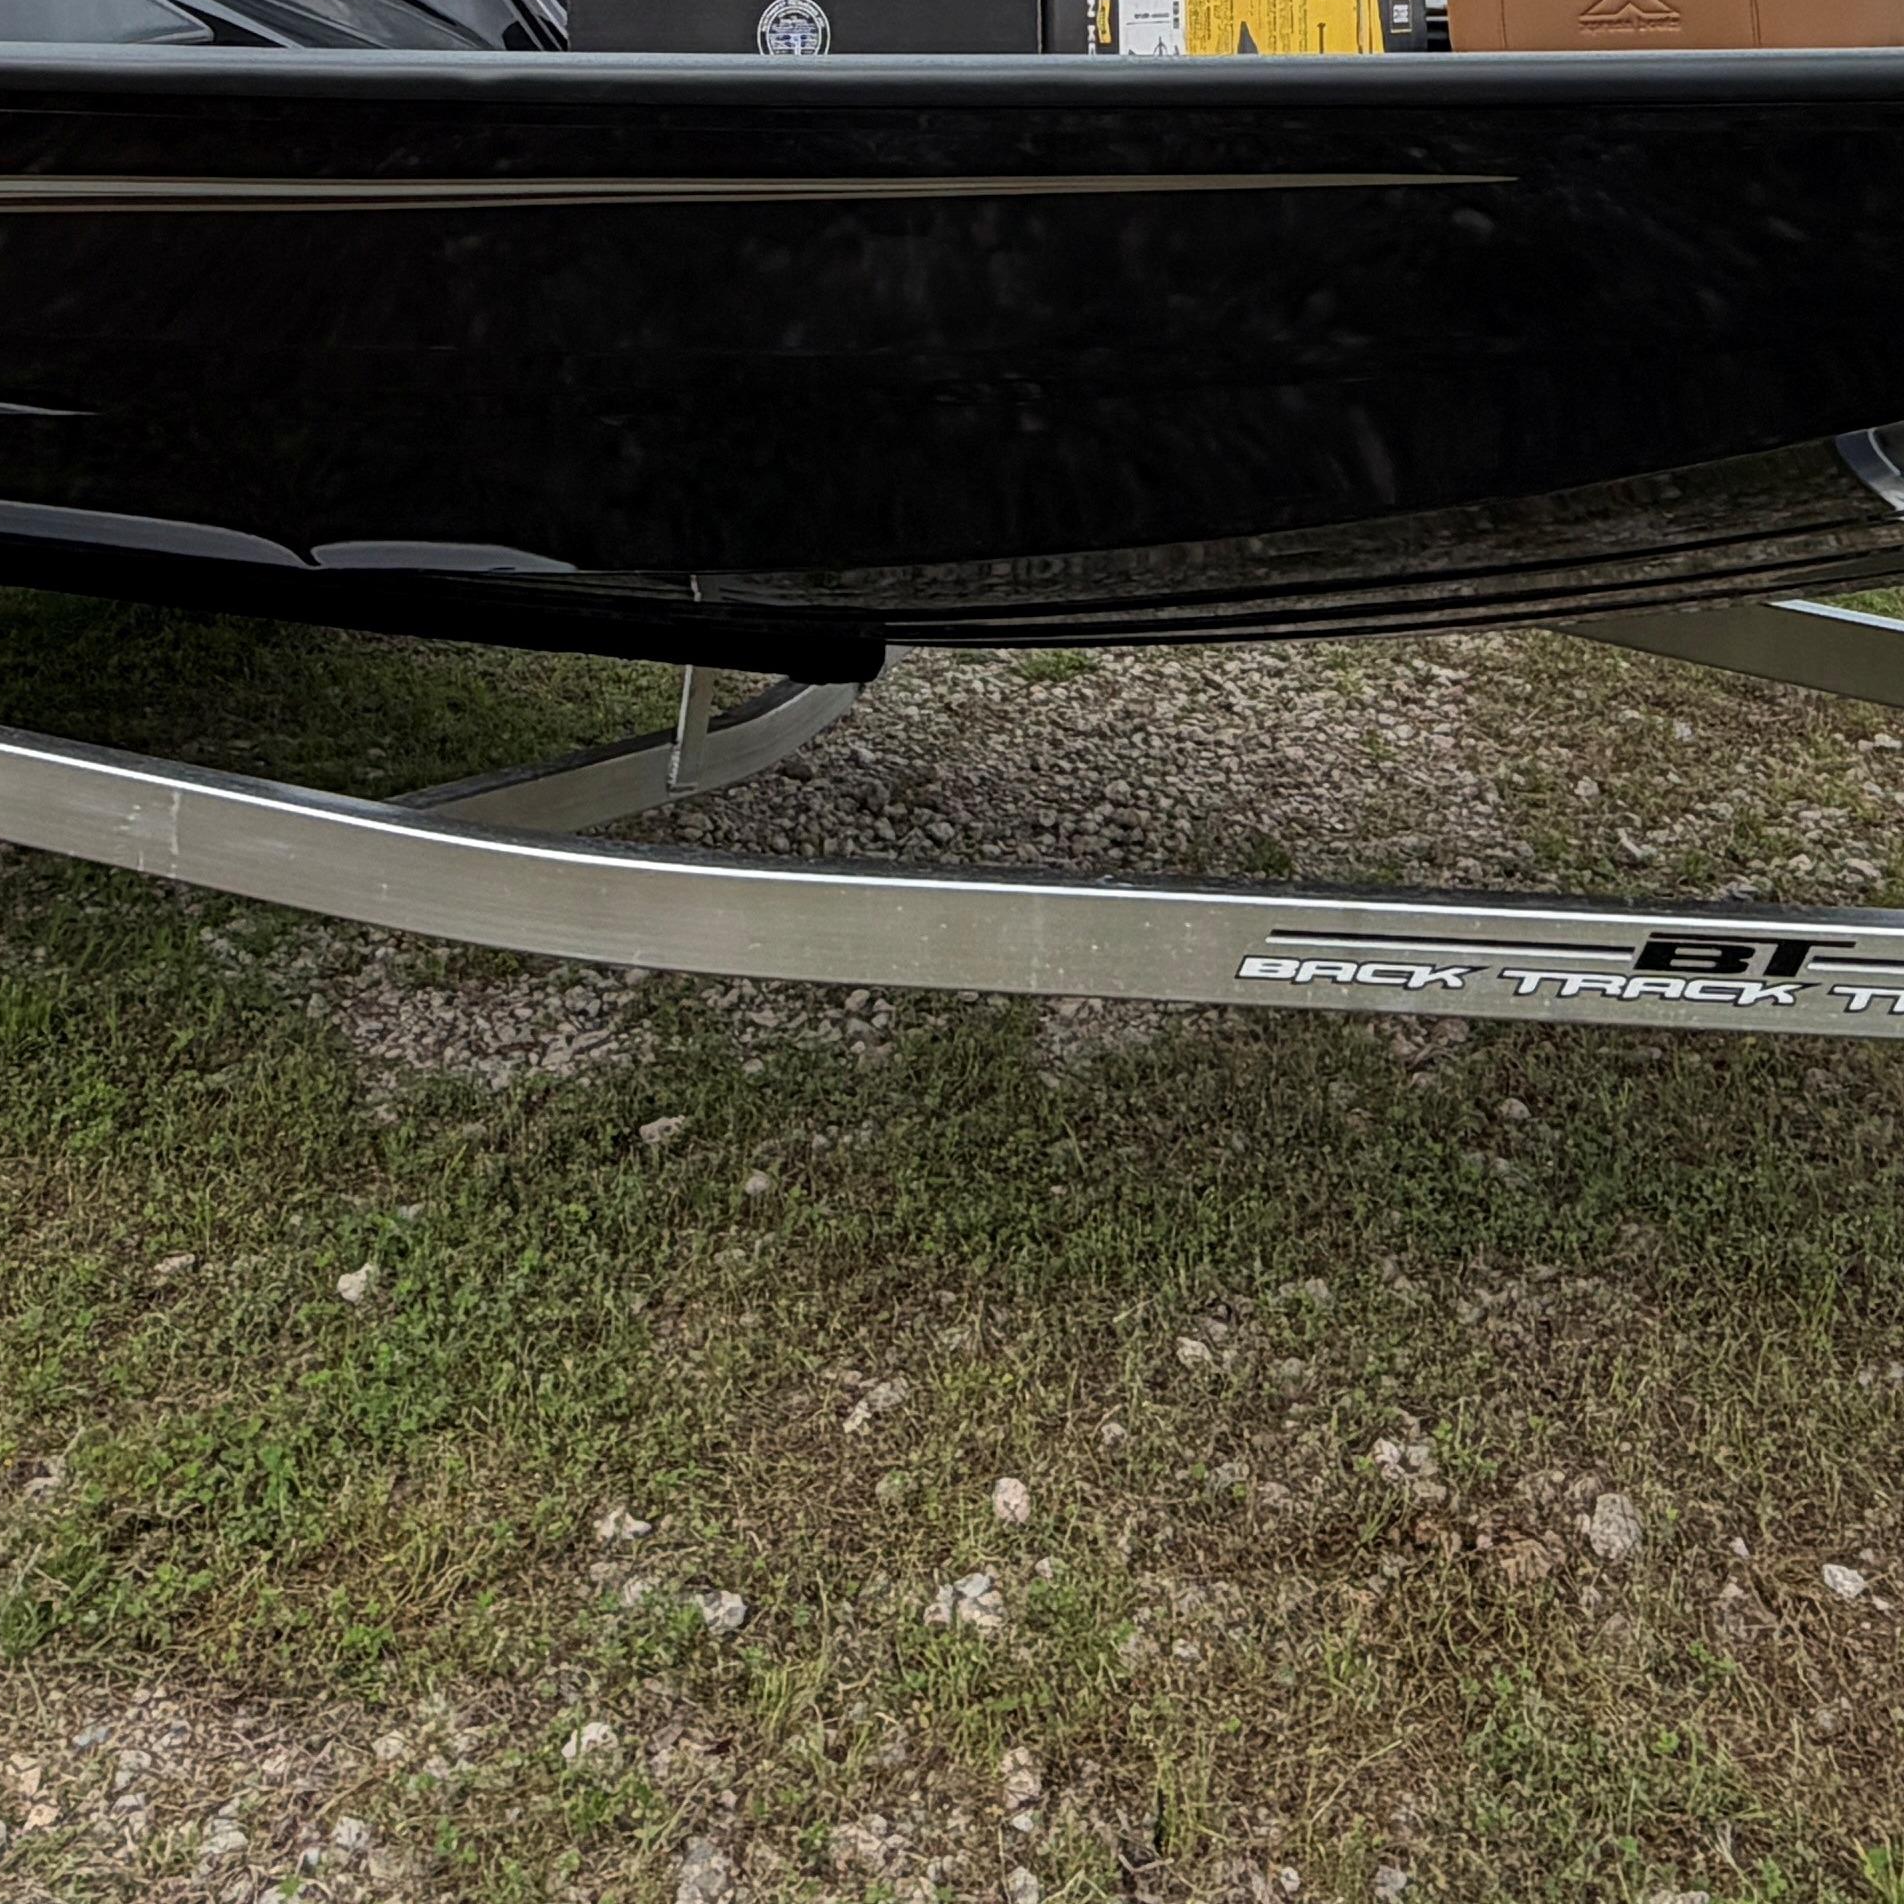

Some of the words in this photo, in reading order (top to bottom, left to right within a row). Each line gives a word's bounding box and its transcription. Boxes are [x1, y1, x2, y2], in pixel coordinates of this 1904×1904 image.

[1235, 954, 1491, 991] BACK
[1497, 965, 1823, 1008] TRACK
[1633, 932, 1858, 980] BT
